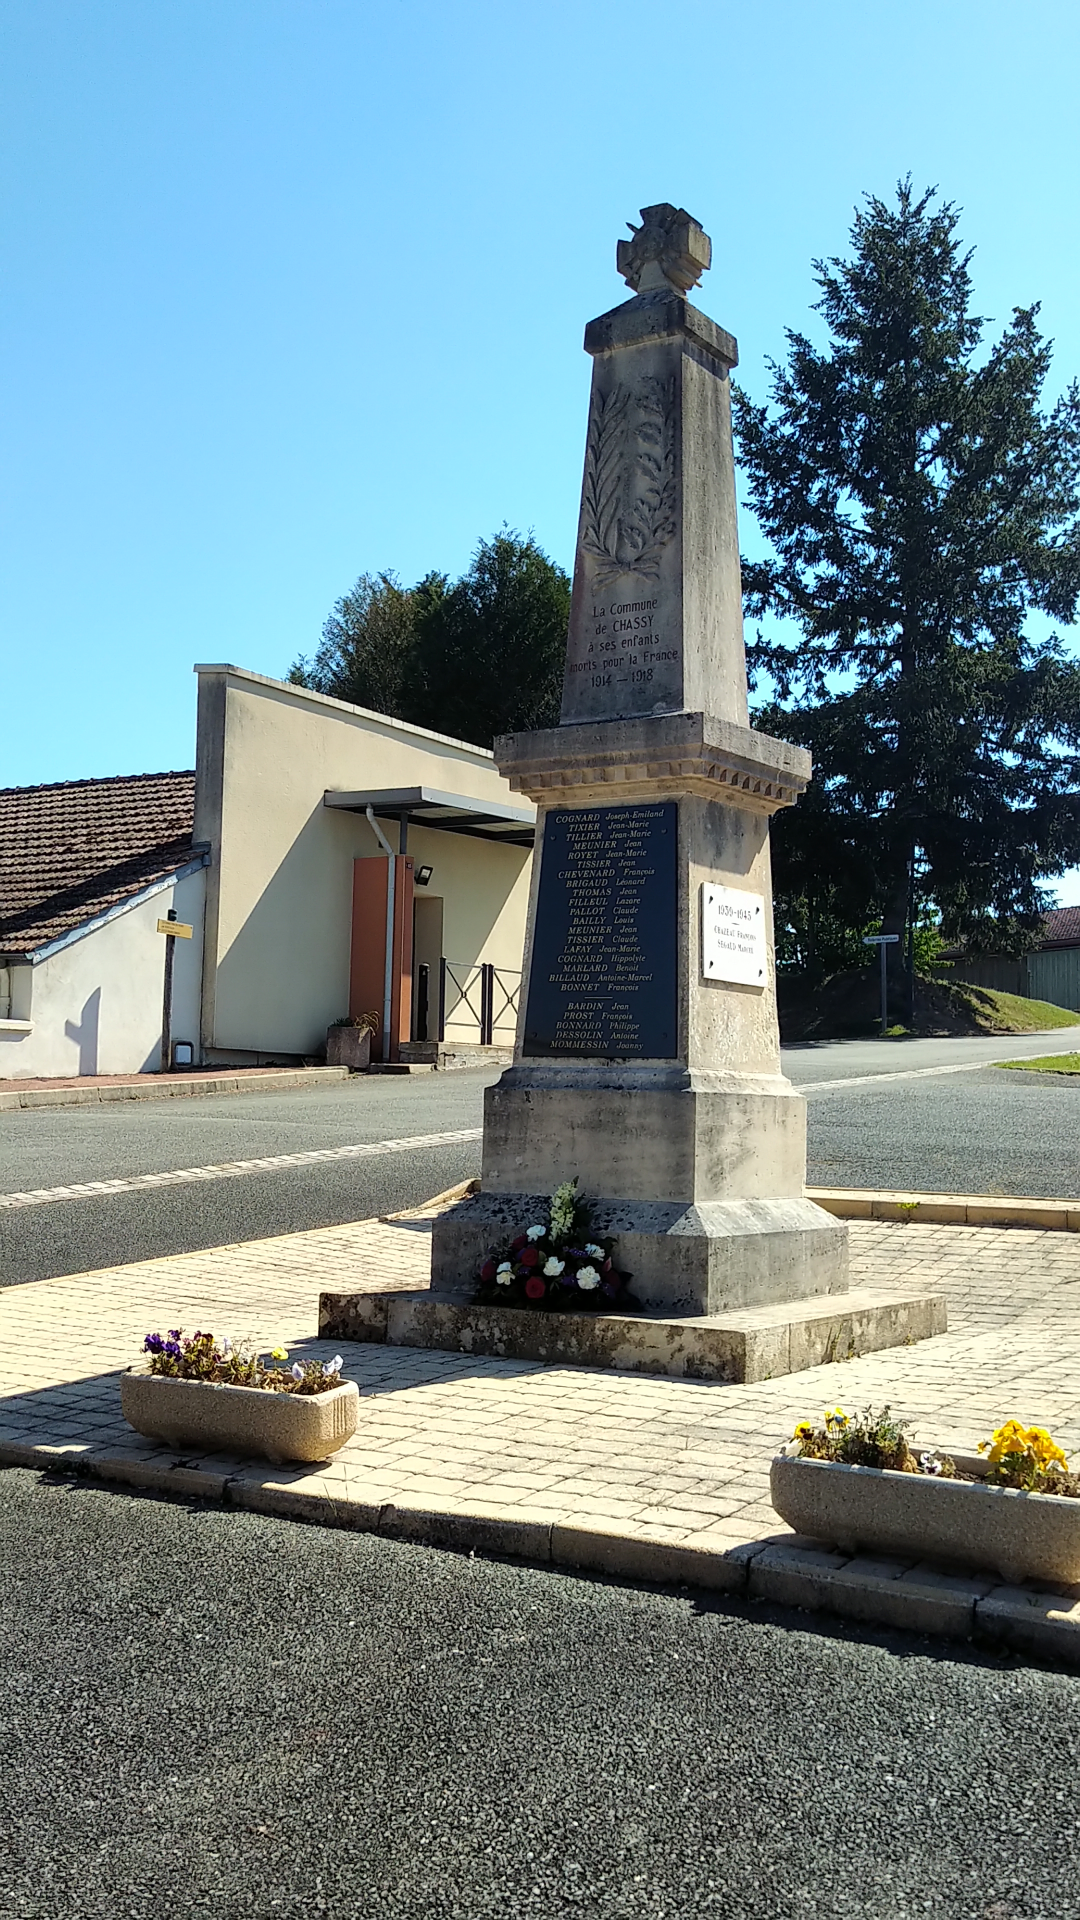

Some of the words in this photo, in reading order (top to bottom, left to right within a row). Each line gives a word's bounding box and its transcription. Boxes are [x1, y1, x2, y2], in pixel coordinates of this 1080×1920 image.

[593, 606, 605, 618] La
[610, 599, 658, 615] Commune
[596, 624, 606, 635] de
[613, 615, 654, 632] CHASSY
[599, 641, 616, 652] ses
[621, 633, 659, 649] enfants
[570, 659, 597, 673] morts
[603, 656, 624, 670] pour
[629, 654, 637, 665] la
[644, 650, 678, 662] France
[591, 675, 612, 688] 1914
[632, 669, 654, 682] 1918
[556, 814, 600, 824] COGNARD
[569, 823, 600, 832] TIXIER
[608, 821, 649, 830] Jean-Marie
[566, 832, 602, 841] TILLIER
[610, 830, 652, 838] Jean-Marie
[573, 841, 617, 850] MEUNIER
[624, 840, 642, 848] Jean
[568, 851, 598, 859] ROYET
[606, 849, 647, 858] Jean-Marie
[577, 860, 611, 868] TISSIER
[558, 869, 616, 879] CHEVENARD
[623, 867, 655, 876] François
[566, 879, 608, 888] BRIGAUD
[572, 888, 612, 896] THOMAS
[568, 898, 608, 906] FILLEUL
[613, 906, 638, 914] Claude
[614, 916, 634, 924] Louis
[568, 926, 612, 934] MEUNIER
[567, 936, 604, 944] TISSIER
[612, 935, 638, 943] Claude
[558, 955, 603, 963] COGNARD
[611, 954, 646, 963] Hippolyte
[549, 974, 590, 982] BILLAUD
[607, 983, 638, 992] François
[568, 1002, 604, 1010] BARDIN
[612, 1002, 629, 1010] Jean
[563, 1012, 594, 1020] PROST
[610, 1022, 640, 1031] Philippe
[556, 1031, 603, 1039] DESSOLIN
[550, 1040, 609, 1049] MOMMESSIN
